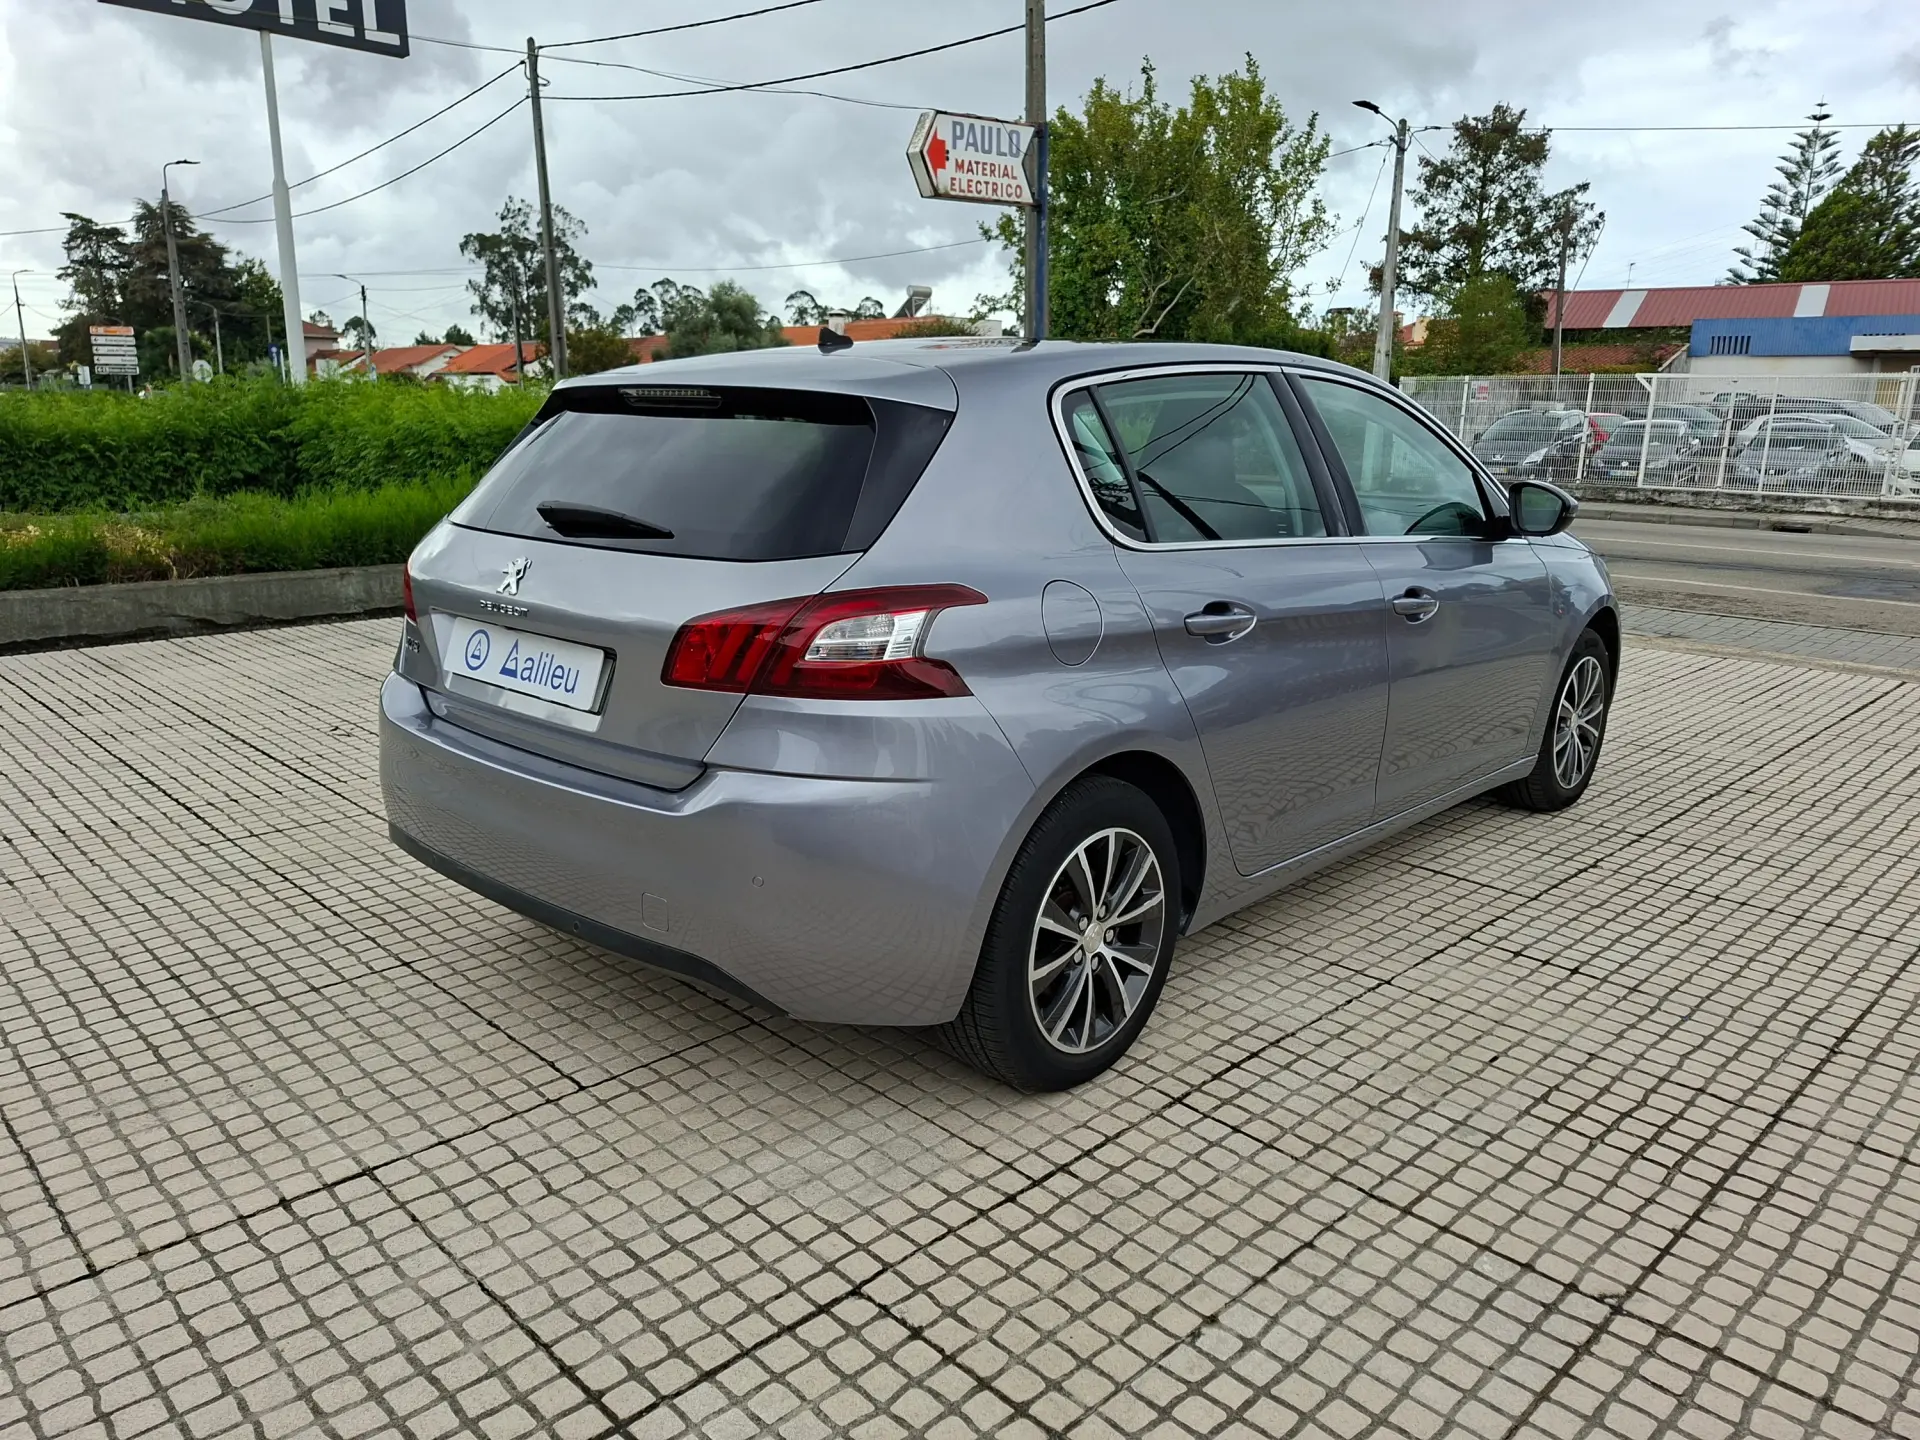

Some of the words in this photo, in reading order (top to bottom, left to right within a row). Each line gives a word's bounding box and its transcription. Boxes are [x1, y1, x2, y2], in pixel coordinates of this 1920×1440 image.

[951, 120, 1021, 159] PAULO
[954, 158, 1018, 180] MATERIAL
[949, 177, 1023, 199] ELECTRICO
[479, 599, 530, 618] PEUGEOT
